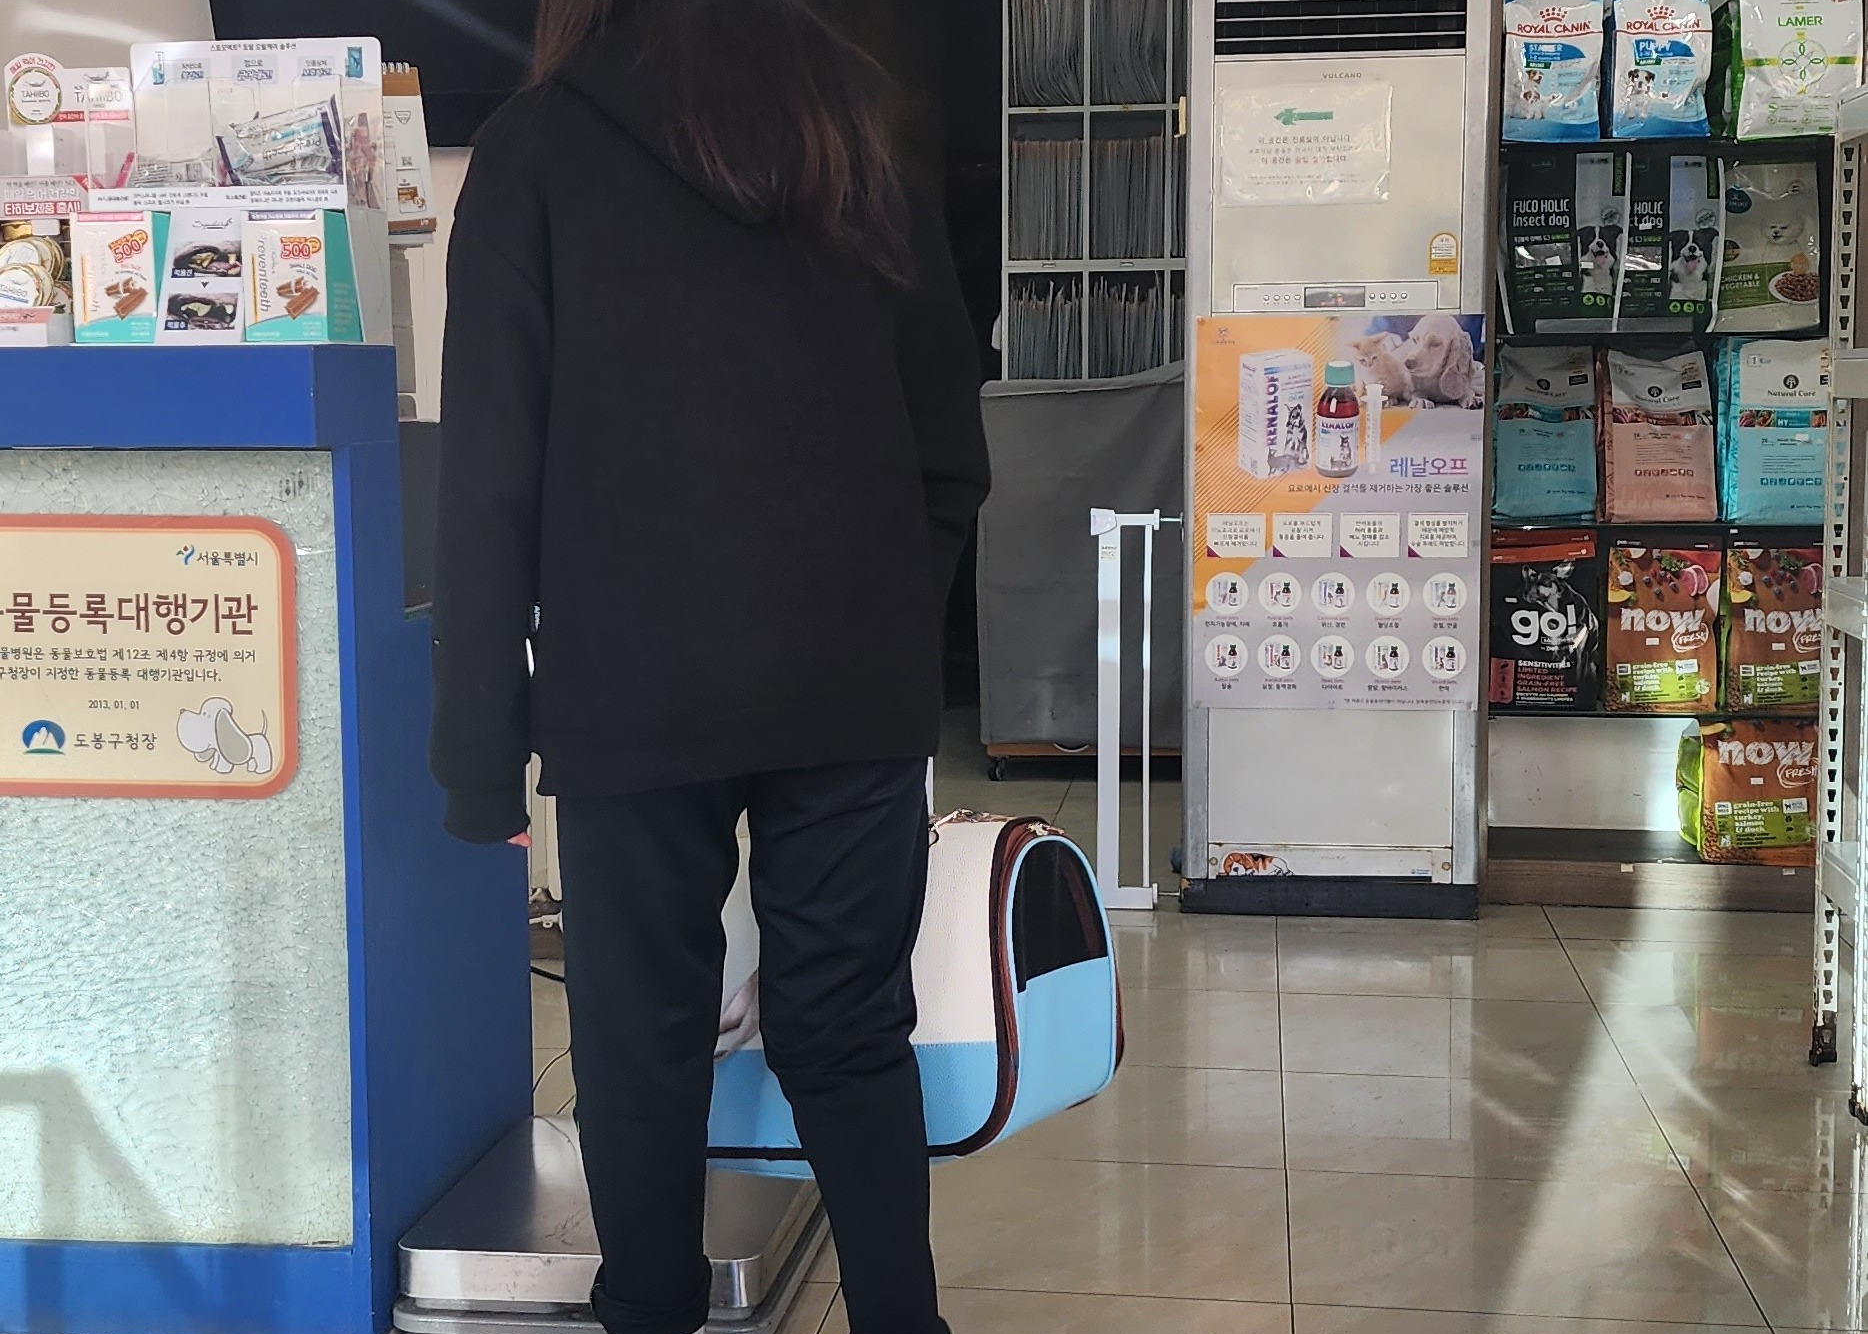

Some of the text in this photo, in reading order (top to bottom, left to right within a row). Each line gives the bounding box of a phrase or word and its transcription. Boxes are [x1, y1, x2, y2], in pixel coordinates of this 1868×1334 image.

[1518, 21, 1591, 33] ROYAL CANIN
[1627, 20, 1660, 31] ROYAL
[1777, 16, 1823, 27] LAMER
[1513, 199, 1570, 213] FUCO HOLIC
[1634, 201, 1664, 214] HOLIC
[1513, 213, 1570, 228] insect dog
[114, 240, 142, 262] 500
[283, 244, 310, 257] 500
[1266, 376, 1279, 447] RENALOF
[1390, 457, 1469, 477] 레날오프
[1369, 483, 1403, 493] 제거하는
[1406, 483, 1422, 493] 가장
[1424, 483, 1441, 493] 좋은
[1444, 483, 1469, 493] 솔루션
[197, 551, 259, 567] 서울특별시
[0, 592, 258, 635] 물등록대행기관
[1620, 608, 1705, 633] now
[1744, 608, 1822, 634] now
[1511, 604, 1577, 645] go!
[49, 647, 107, 661] 동물보호법
[112, 648, 151, 661] 제12조
[156, 648, 188, 662] 제4항
[193, 649, 228, 663] 규정에
[233, 649, 256, 663] 의거
[46, 666, 79, 680] 지정한
[84, 667, 131, 681] 동물등록
[137, 667, 222, 682] 대행기관입니다.
[88, 699, 140, 710] 2013. 01. 01
[74, 732, 158, 751] 도봉구청장
[1718, 740, 1815, 765] now
[1733, 801, 1774, 809] grain-free
